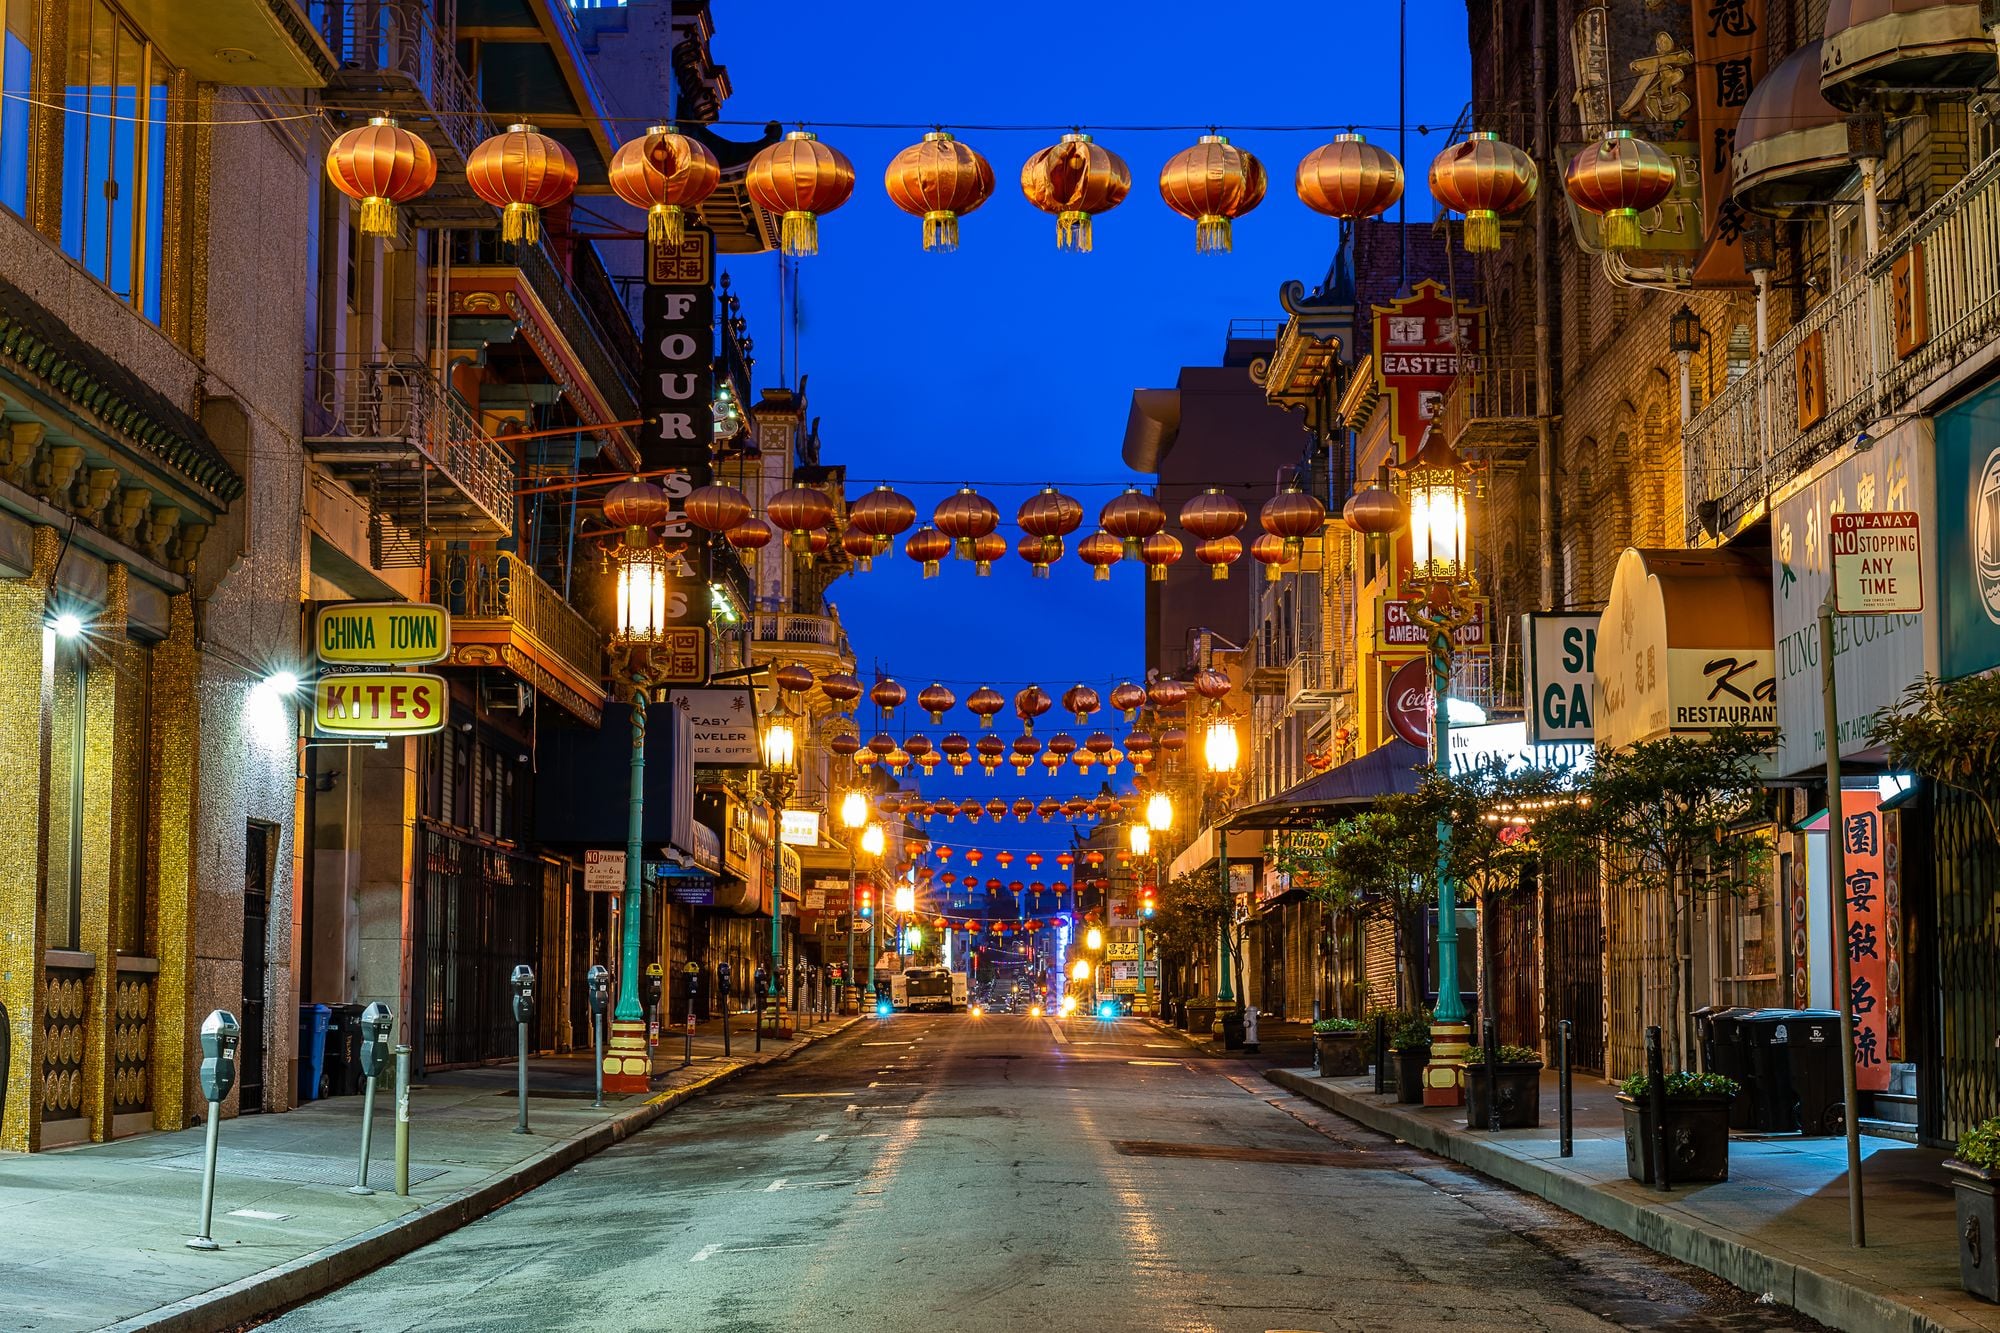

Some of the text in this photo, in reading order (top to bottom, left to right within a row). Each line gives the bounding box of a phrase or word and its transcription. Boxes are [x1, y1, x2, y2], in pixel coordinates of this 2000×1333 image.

[662, 293, 699, 441] FOUR
[1837, 515, 1913, 529] TOW-AWAY
[662, 473, 697, 618] SEAS
[1834, 531, 1916, 554] NO STOPPING
[1860, 558, 1894, 575] ANY
[1858, 577, 1898, 596] TIME
[324, 615, 438, 650] CHINA TOWN
[1778, 623, 1818, 680] TUNG
[326, 685, 431, 719] KITES
[1543, 683, 1595, 729] GA
[1452, 732, 1470, 748] the
[1519, 744, 1585, 772] SHOP
[586, 851, 624, 863] NO PARKING
